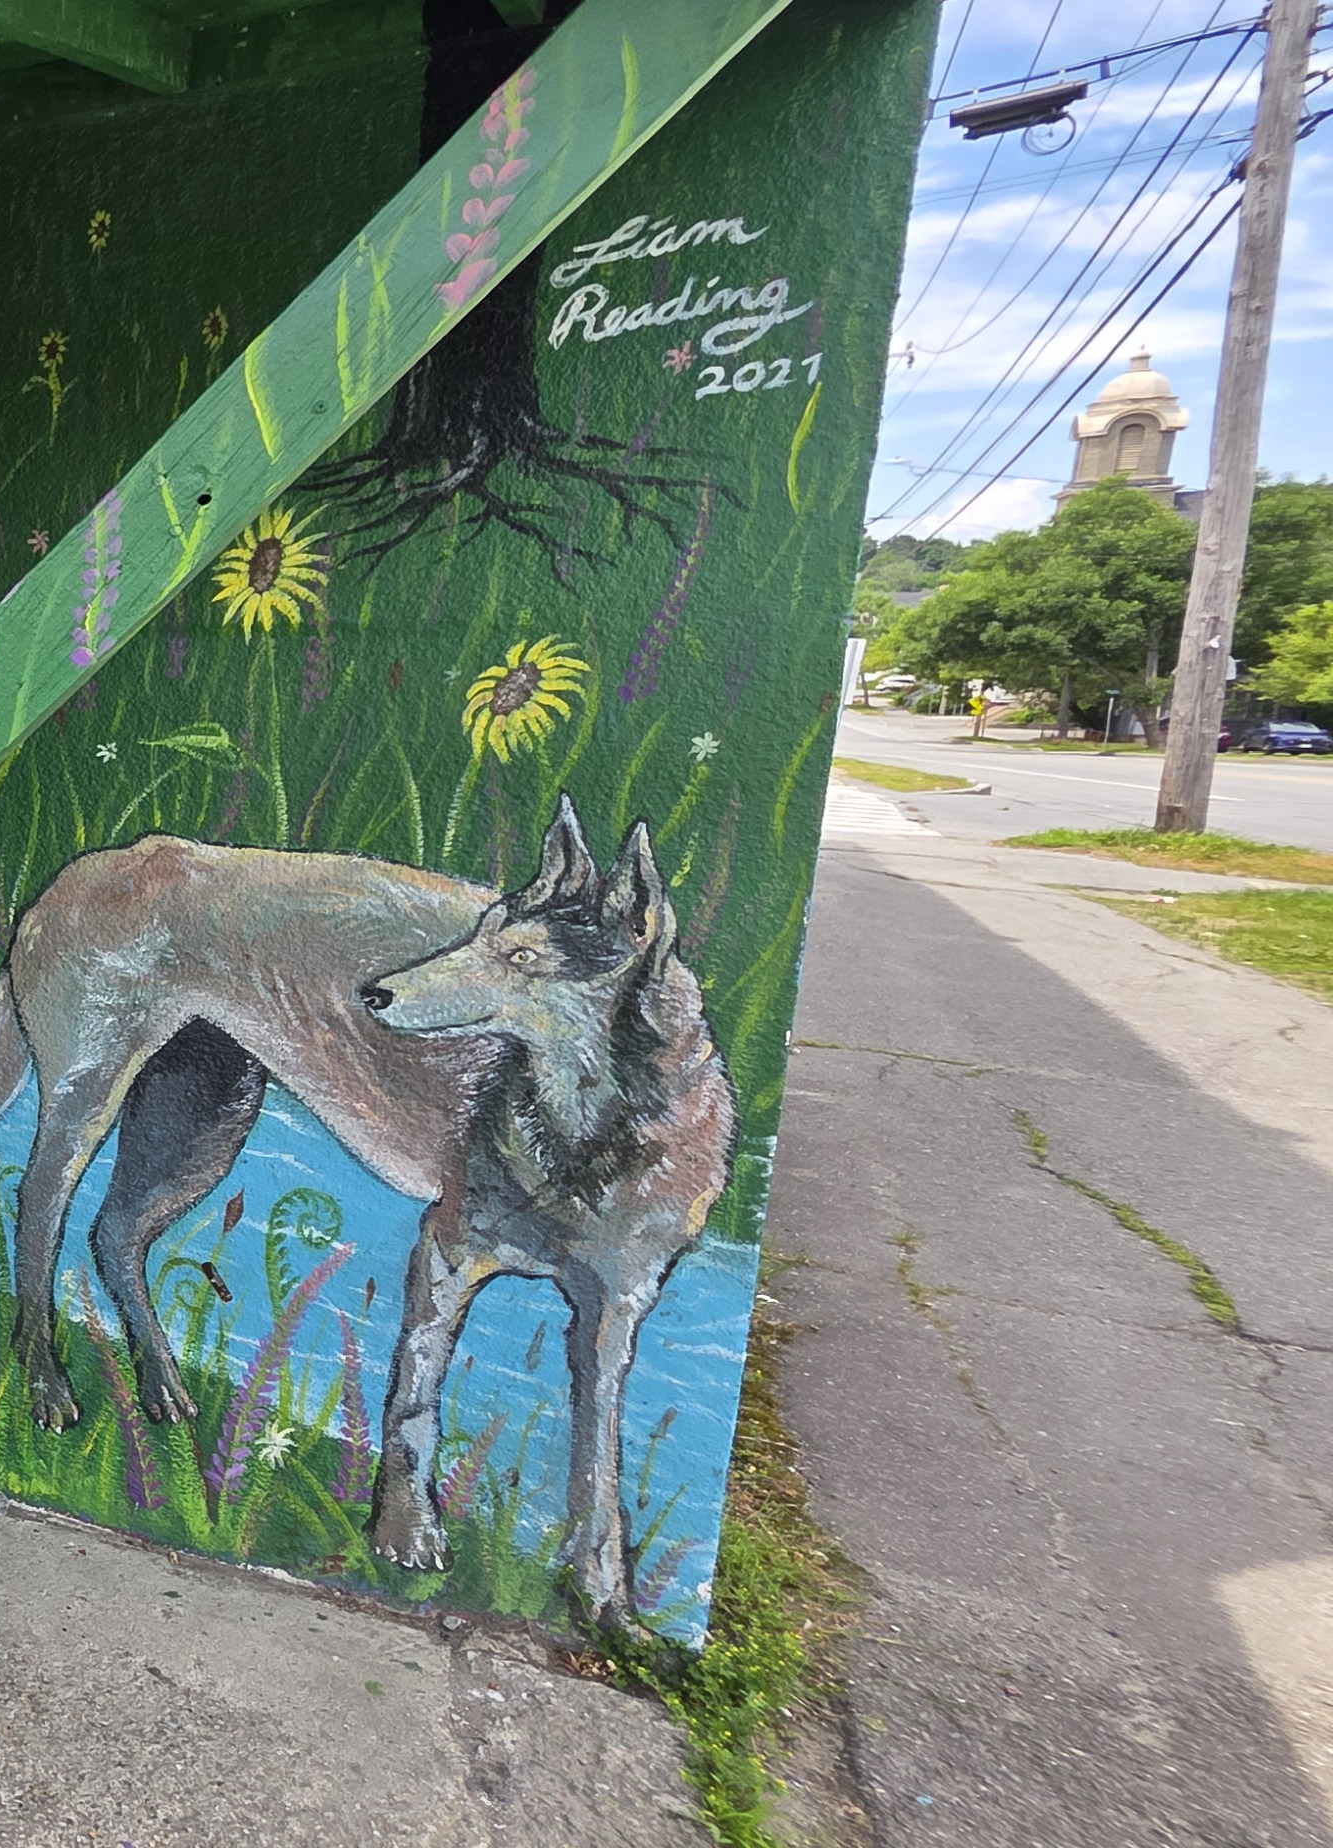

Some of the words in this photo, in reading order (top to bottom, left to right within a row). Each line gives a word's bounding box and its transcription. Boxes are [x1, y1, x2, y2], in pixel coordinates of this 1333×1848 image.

[549, 214, 770, 289] Liam
[548, 275, 816, 356] Reading
[695, 352, 824, 401] 2021
